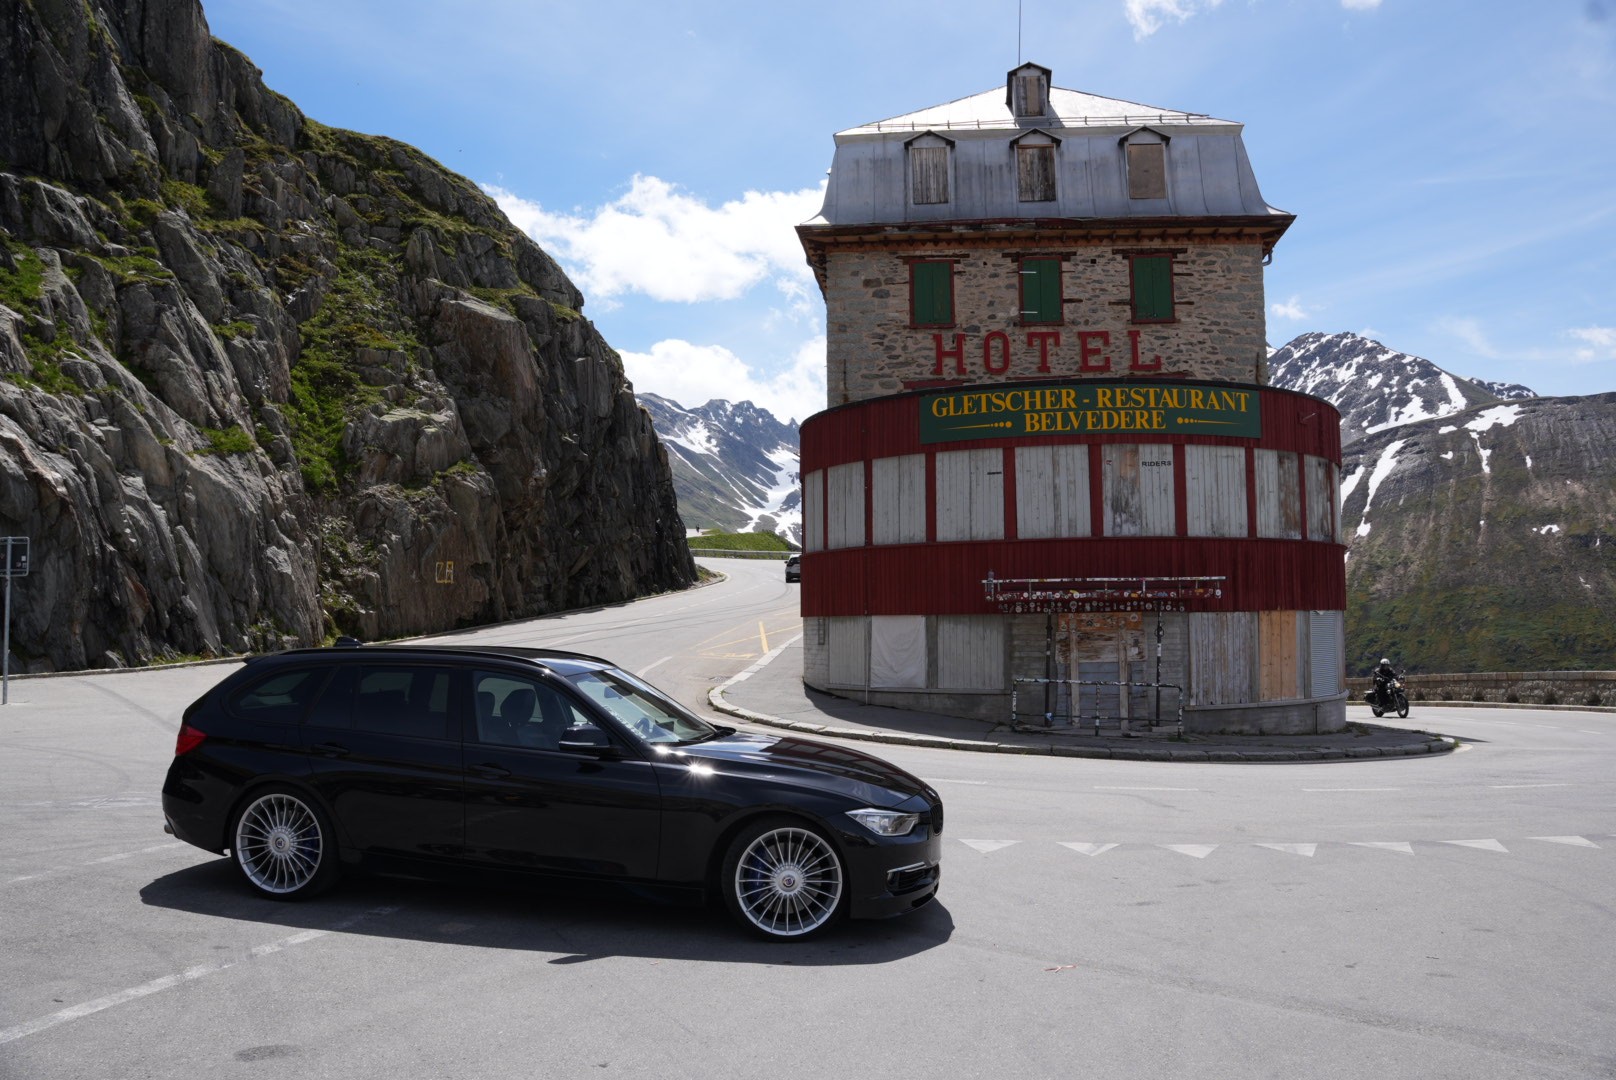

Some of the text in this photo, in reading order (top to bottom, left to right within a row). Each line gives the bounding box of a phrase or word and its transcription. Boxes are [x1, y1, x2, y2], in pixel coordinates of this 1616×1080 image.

[932, 330, 1162, 375] HOTEL
[931, 388, 1078, 418] GLETSCHER
[1096, 387, 1250, 413] RESTAURANT
[1024, 410, 1167, 432] BELVEDERE
